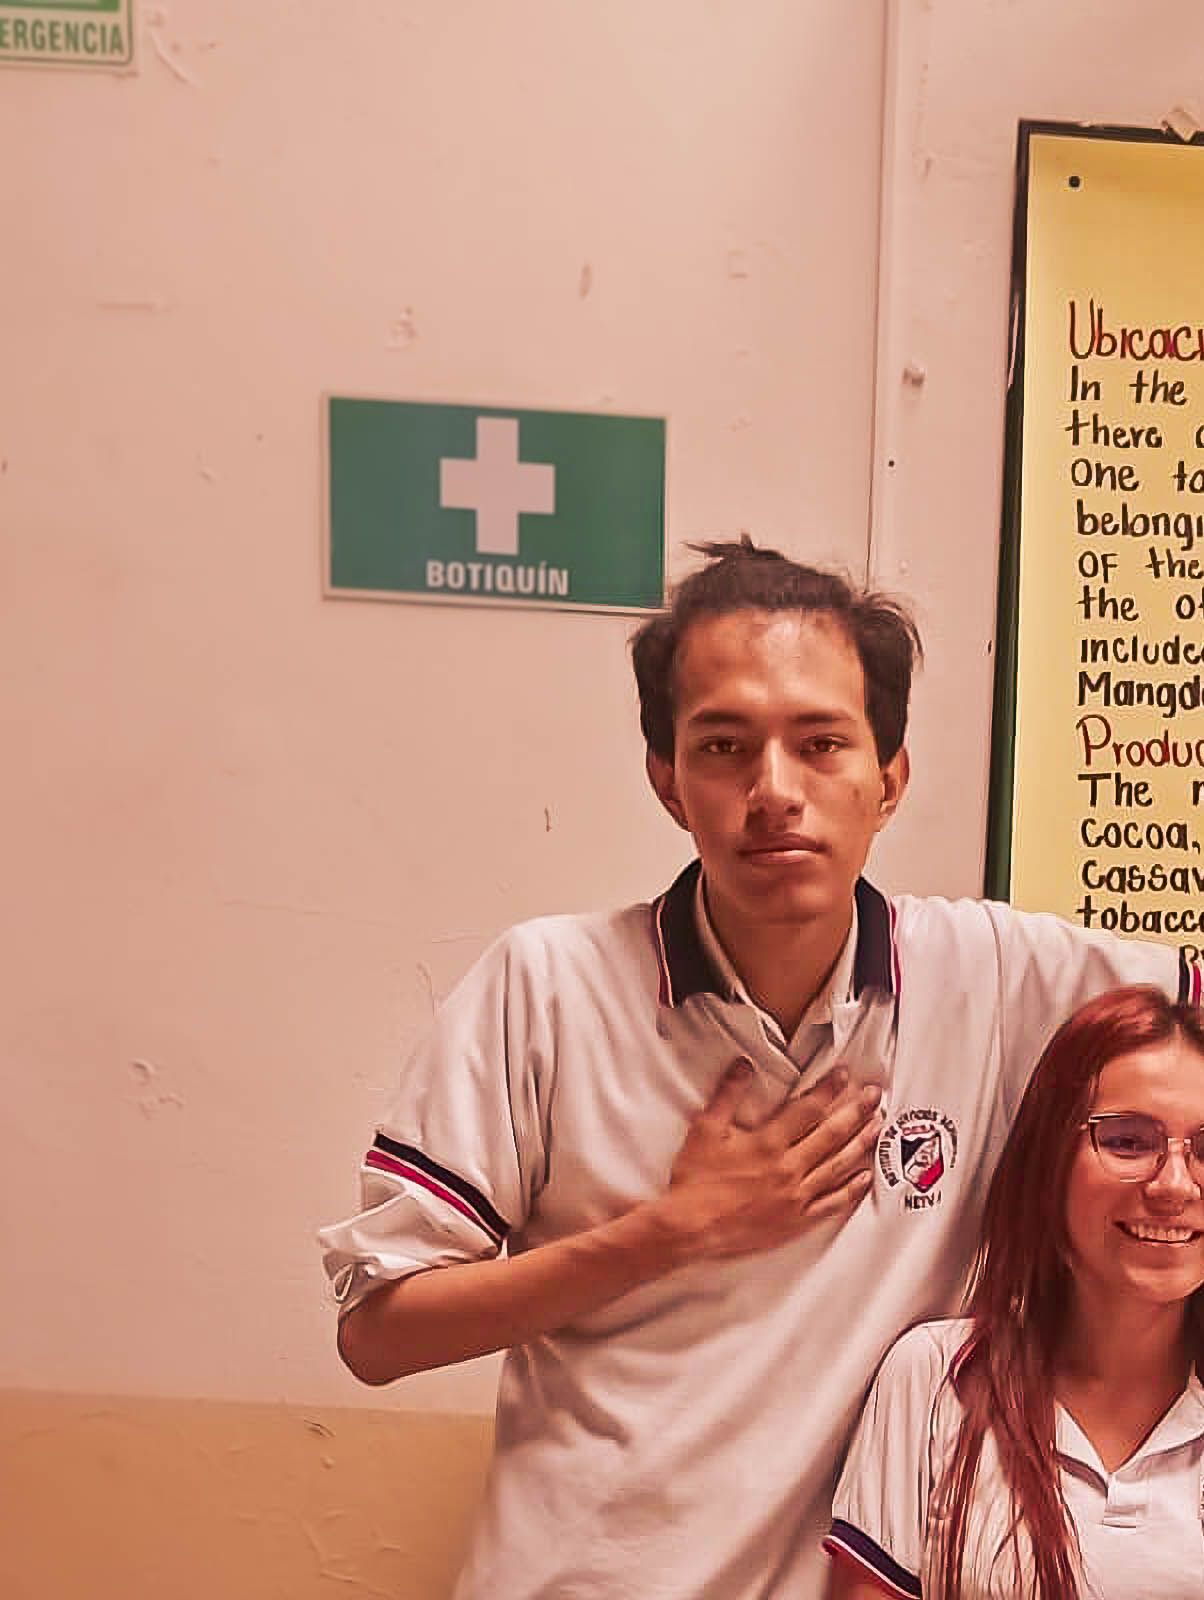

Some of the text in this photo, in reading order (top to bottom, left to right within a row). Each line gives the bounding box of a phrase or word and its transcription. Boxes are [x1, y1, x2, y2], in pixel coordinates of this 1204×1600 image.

[1068, 366, 1101, 401] In
[1130, 369, 1187, 406] the
[1065, 410, 1162, 448] there
[427, 560, 568, 595] BOTIQUÍN
[1146, 547, 1204, 580] the
[1075, 585, 1139, 621] the
[1078, 773, 1152, 808] The
